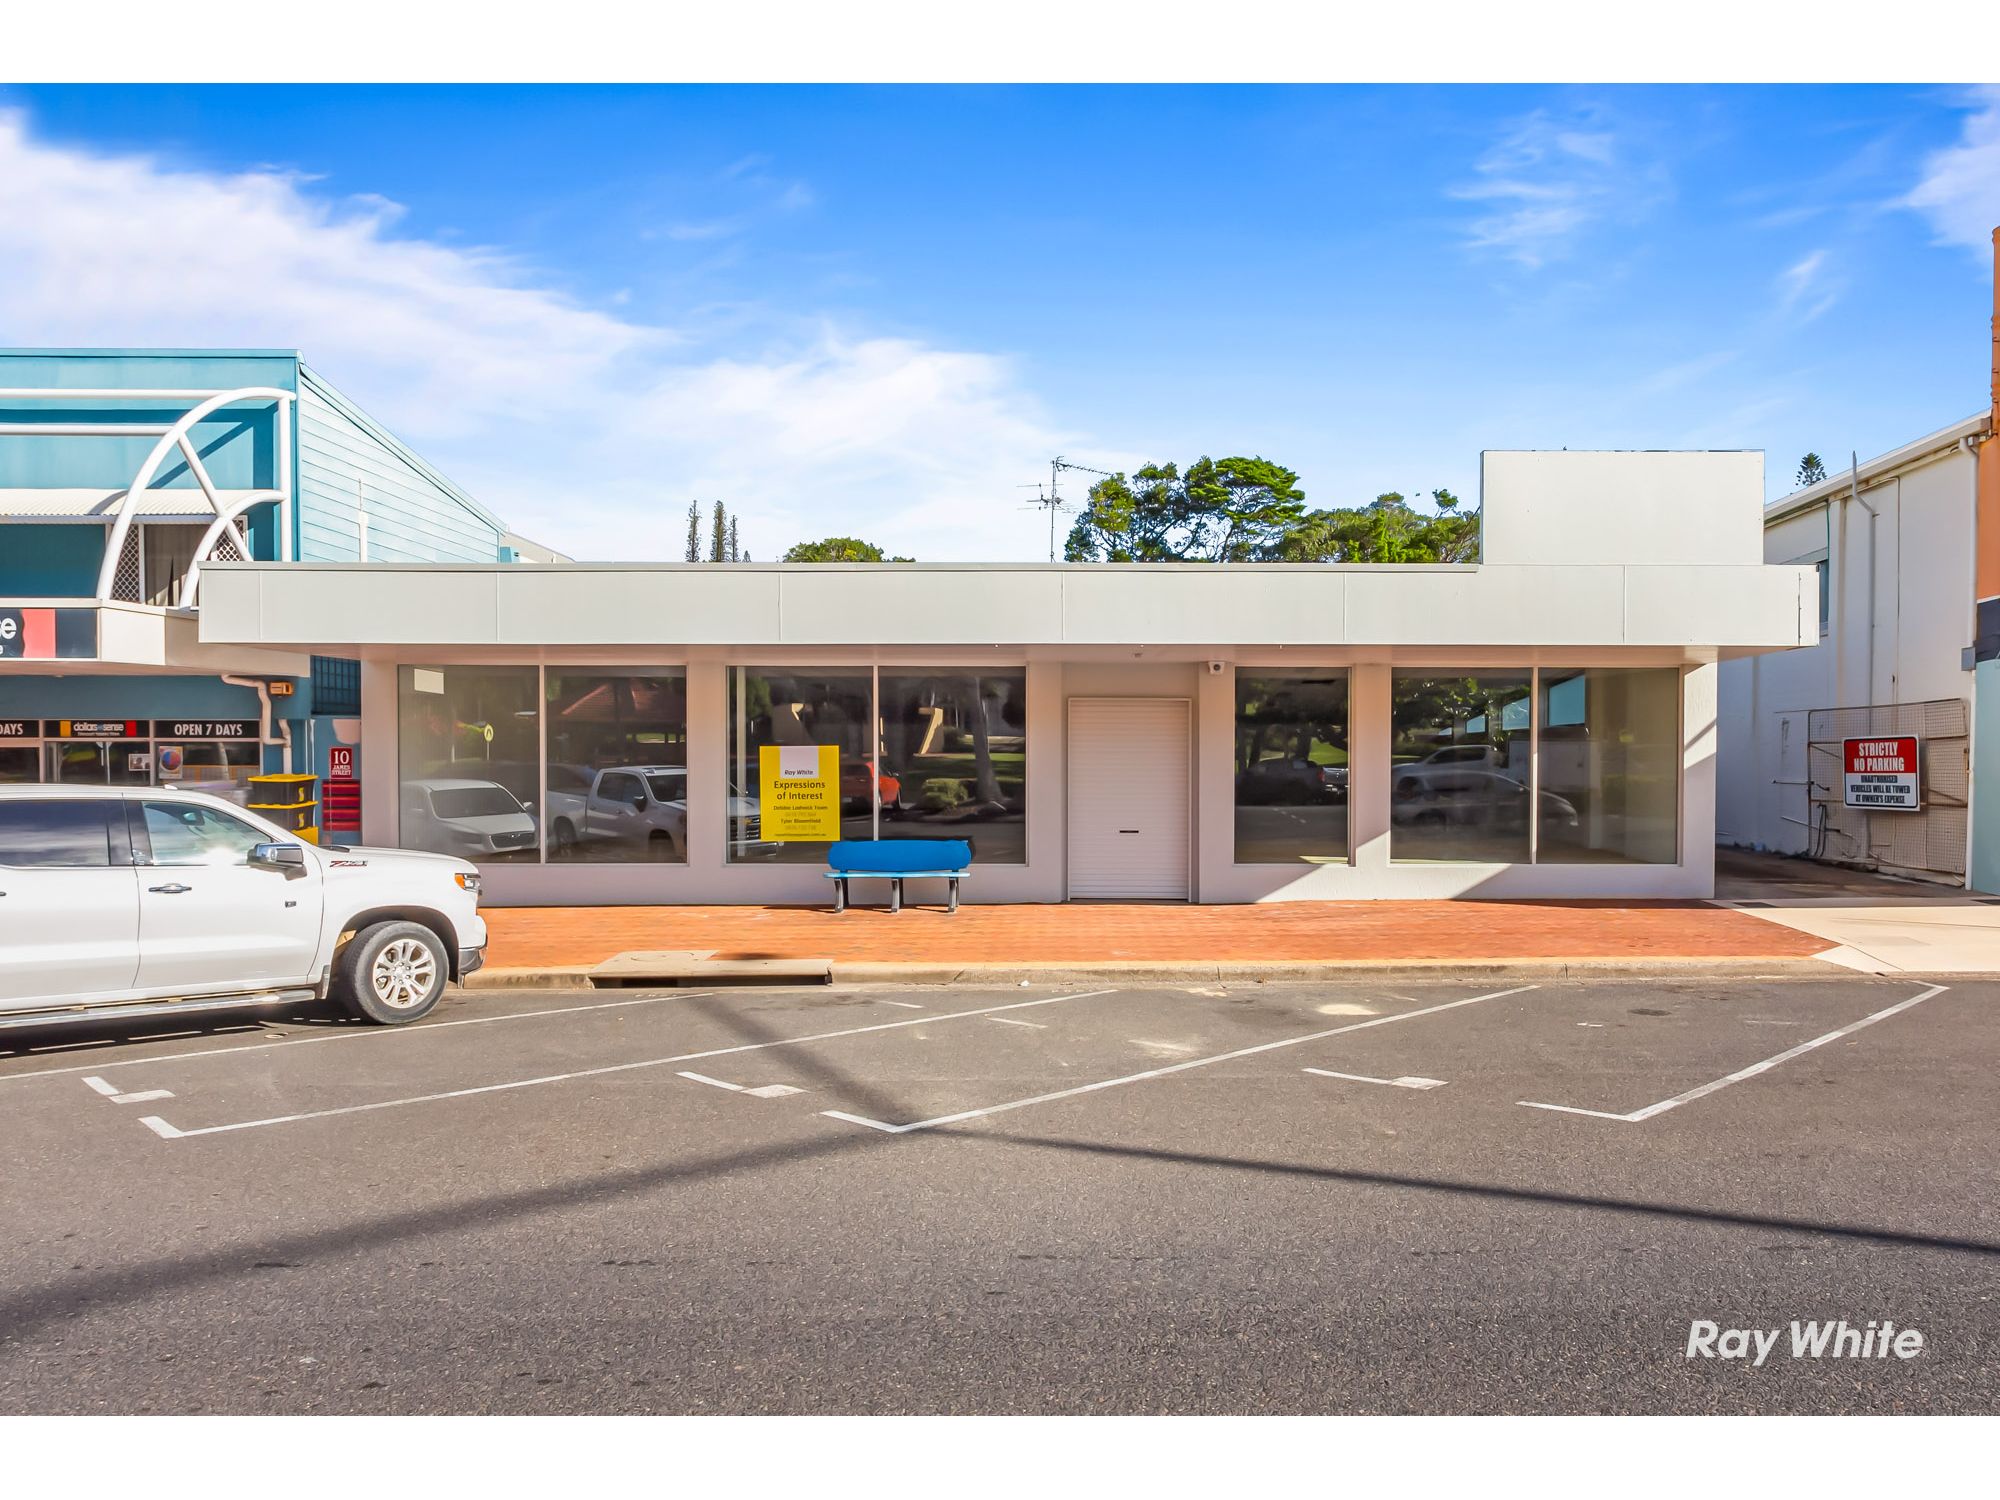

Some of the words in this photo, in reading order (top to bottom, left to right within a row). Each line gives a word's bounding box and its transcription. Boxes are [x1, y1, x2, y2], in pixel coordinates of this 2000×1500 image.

[174, 724, 202, 735] OPEN
[206, 724, 212, 735] 7
[215, 724, 243, 735] DAYS
[1858, 742, 1898, 757] STRICTLY
[334, 750, 350, 765] 10
[1854, 758, 1865, 771] NO
[1867, 757, 1905, 771] PARKING
[774, 780, 826, 790] Expressions
[776, 791, 786, 800] of
[788, 792, 823, 800] Interest
